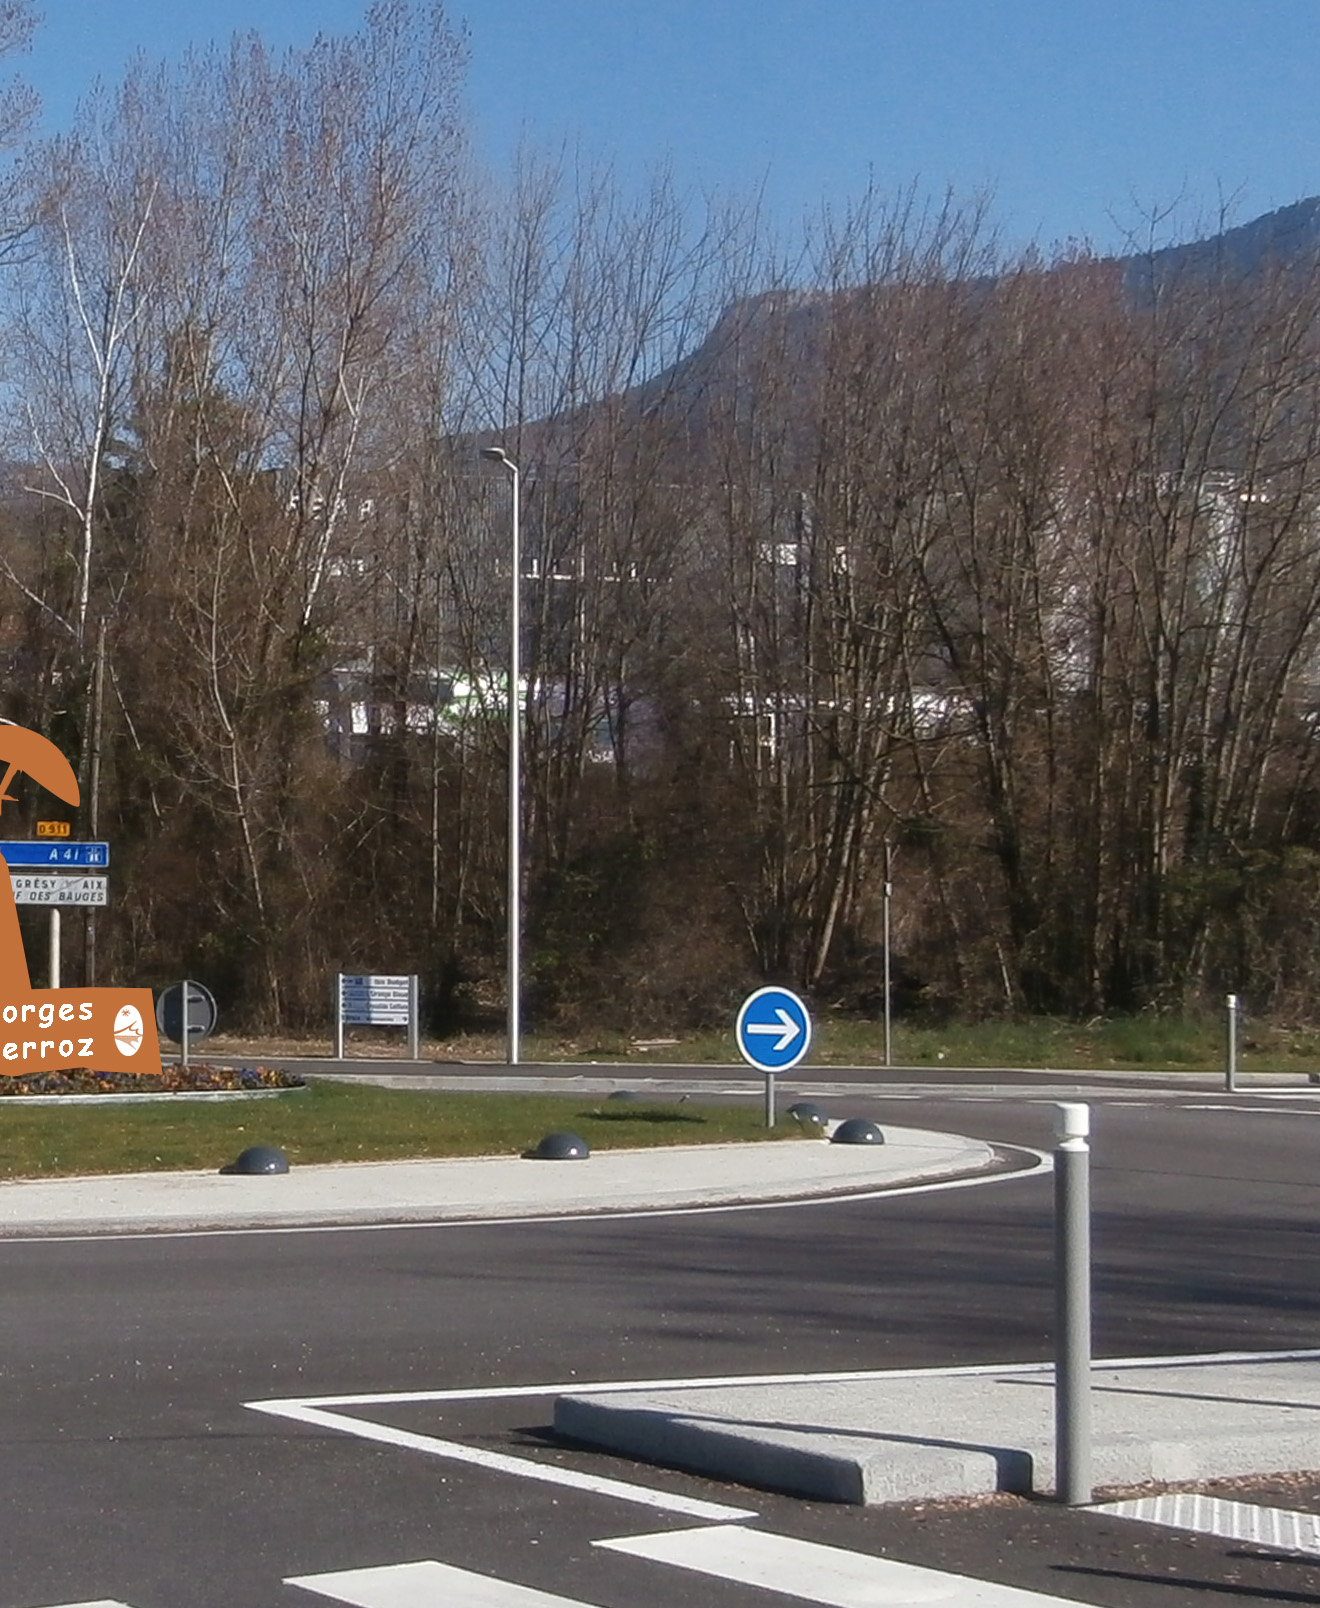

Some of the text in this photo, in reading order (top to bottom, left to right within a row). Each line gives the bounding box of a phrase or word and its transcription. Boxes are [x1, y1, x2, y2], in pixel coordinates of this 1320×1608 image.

[49, 848, 79, 861] A 41
[16, 877, 103, 889] GRÉSY AIX
[29, 891, 51, 901] DES
[59, 891, 104, 902] BAUGES
